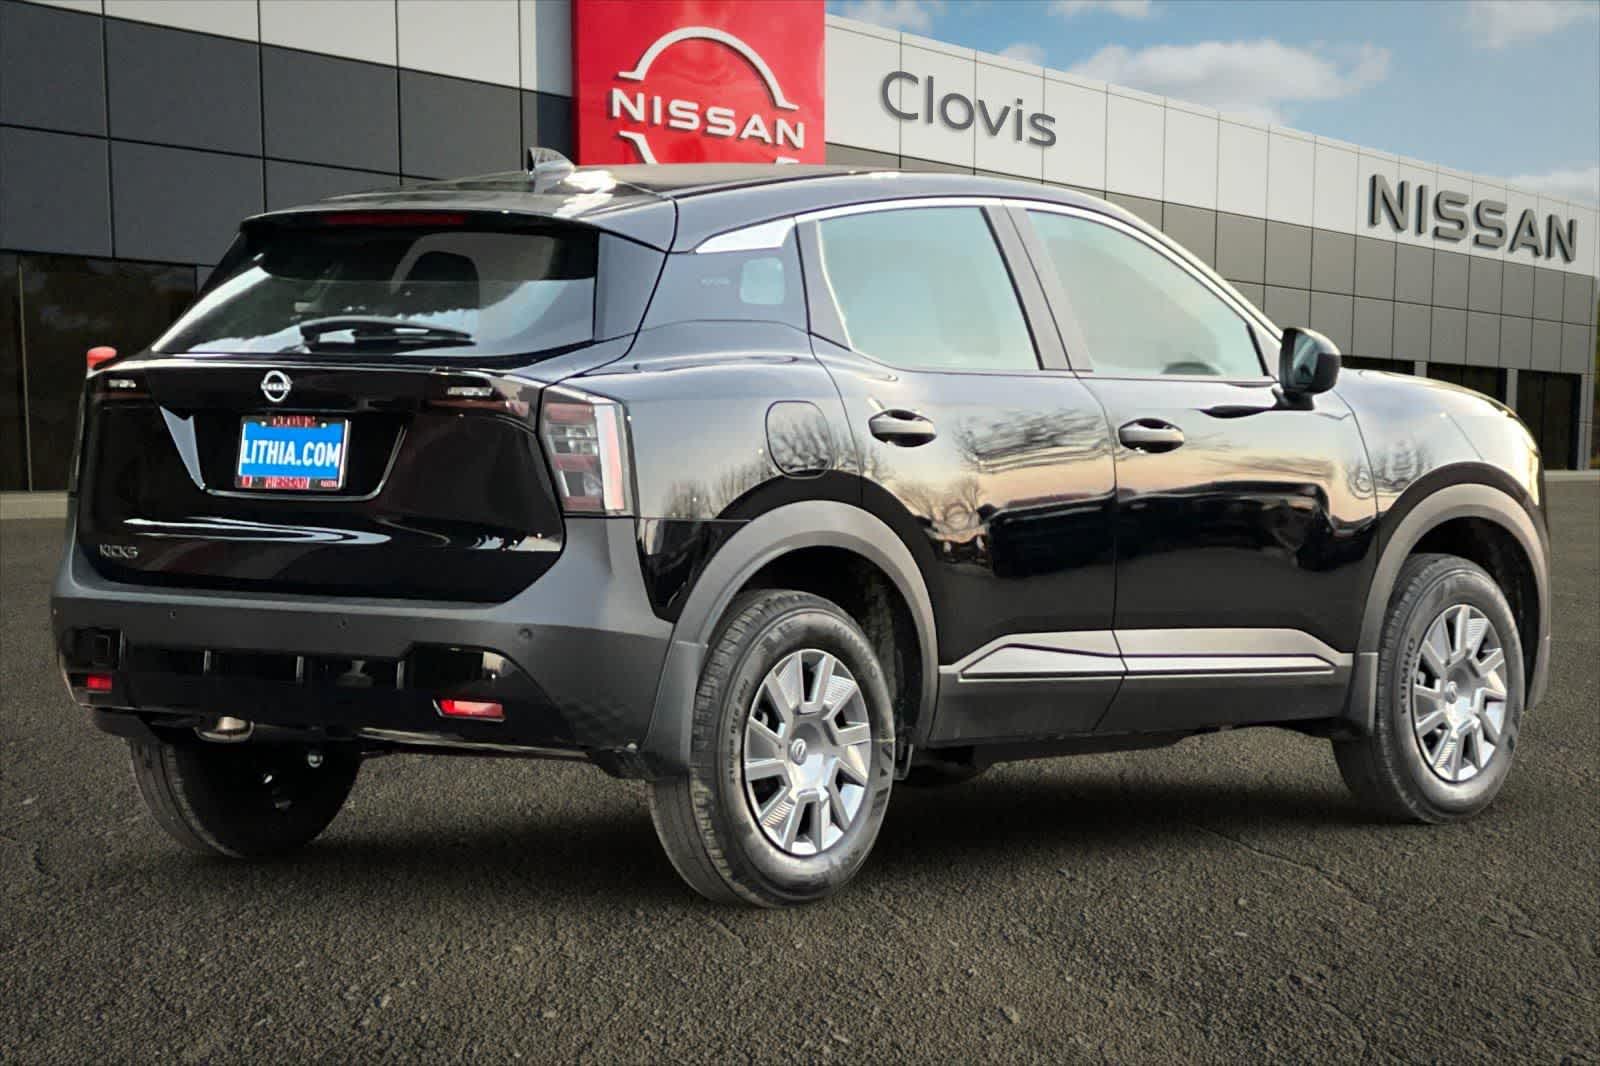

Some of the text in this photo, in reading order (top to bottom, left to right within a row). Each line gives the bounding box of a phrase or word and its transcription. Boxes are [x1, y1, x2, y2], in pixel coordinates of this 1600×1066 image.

[611, 87, 805, 149] NISSAN
[881, 71, 1057, 146] Clovis
[1368, 174, 1577, 263] NISSAN
[241, 439, 341, 467] LITHIA.COM
[98, 543, 138, 558] KICKS
